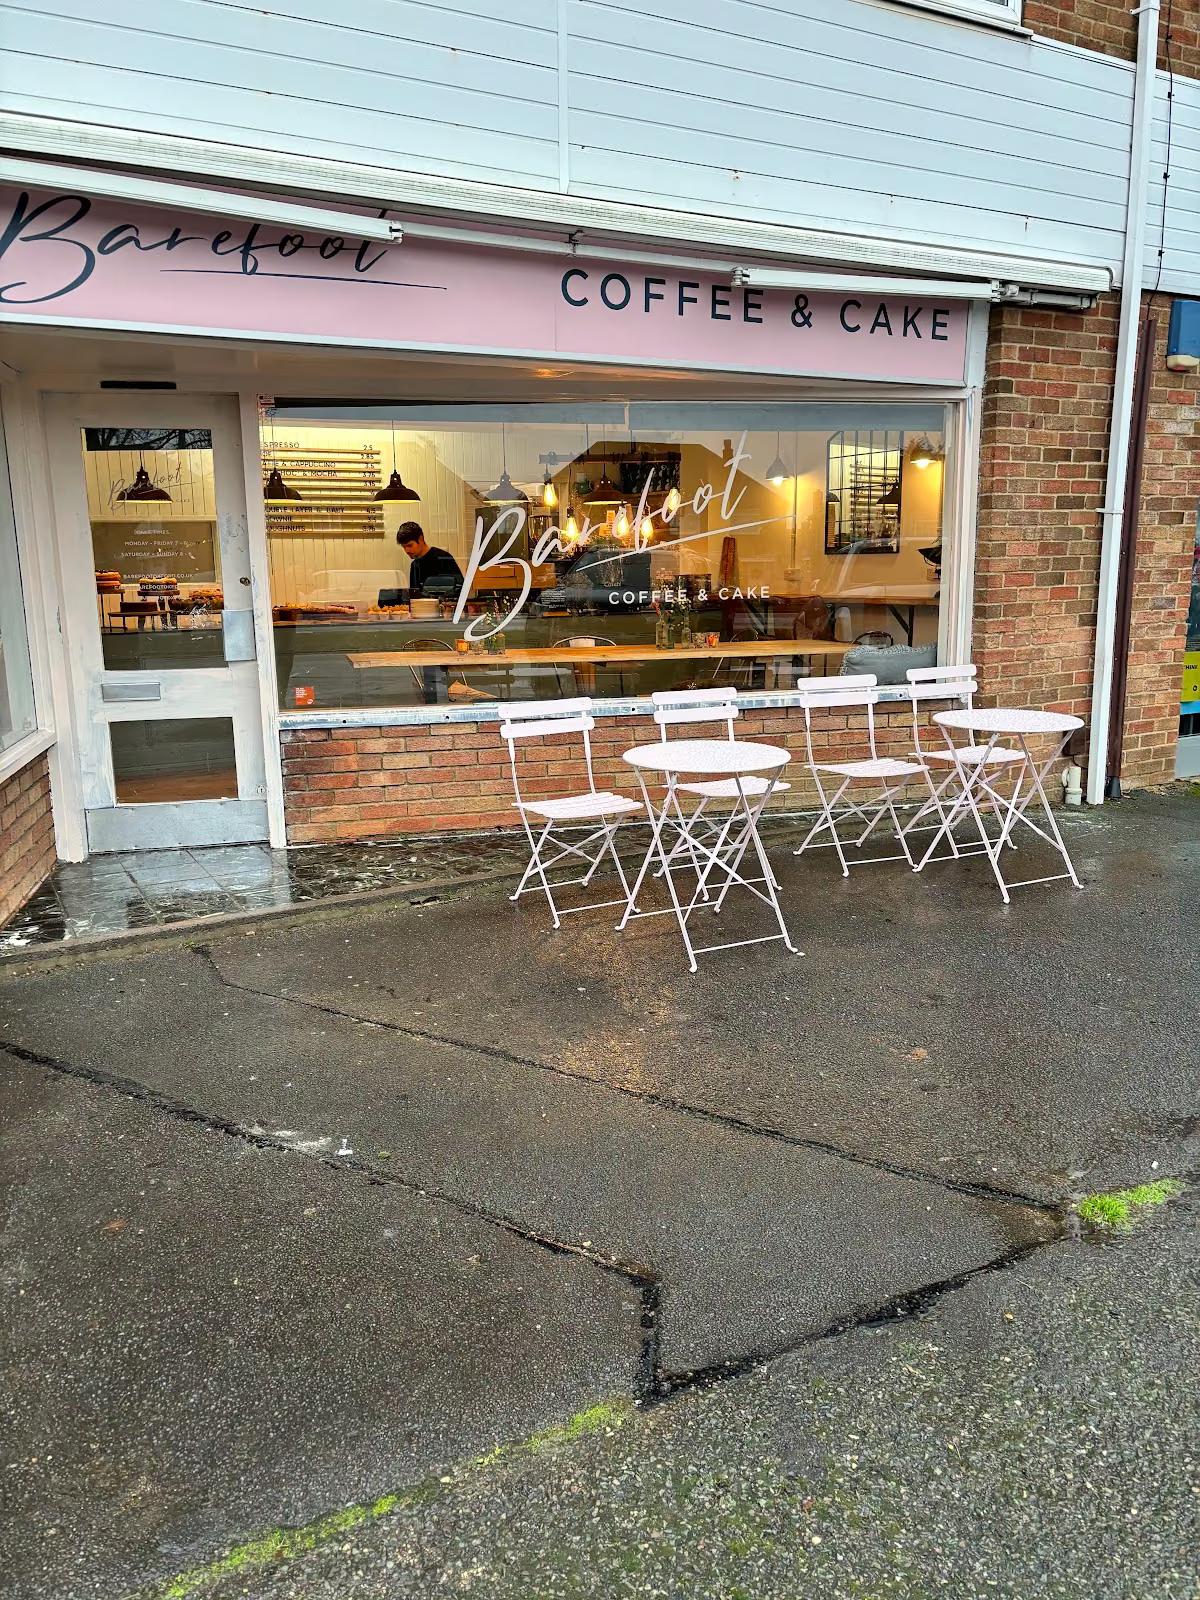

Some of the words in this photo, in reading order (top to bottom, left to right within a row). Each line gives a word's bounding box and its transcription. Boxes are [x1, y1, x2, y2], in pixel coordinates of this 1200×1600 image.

[0, 191, 392, 304] Barefoot
[561, 268, 764, 325] COFFEE
[790, 293, 813, 329] &
[839, 299, 951, 342] CAKE
[263, 441, 300, 449] SPRESSO
[452, 430, 752, 642] Barefoot
[608, 588, 688, 606] COFFEE
[697, 587, 709, 602] &
[718, 585, 771, 601] CAKE
